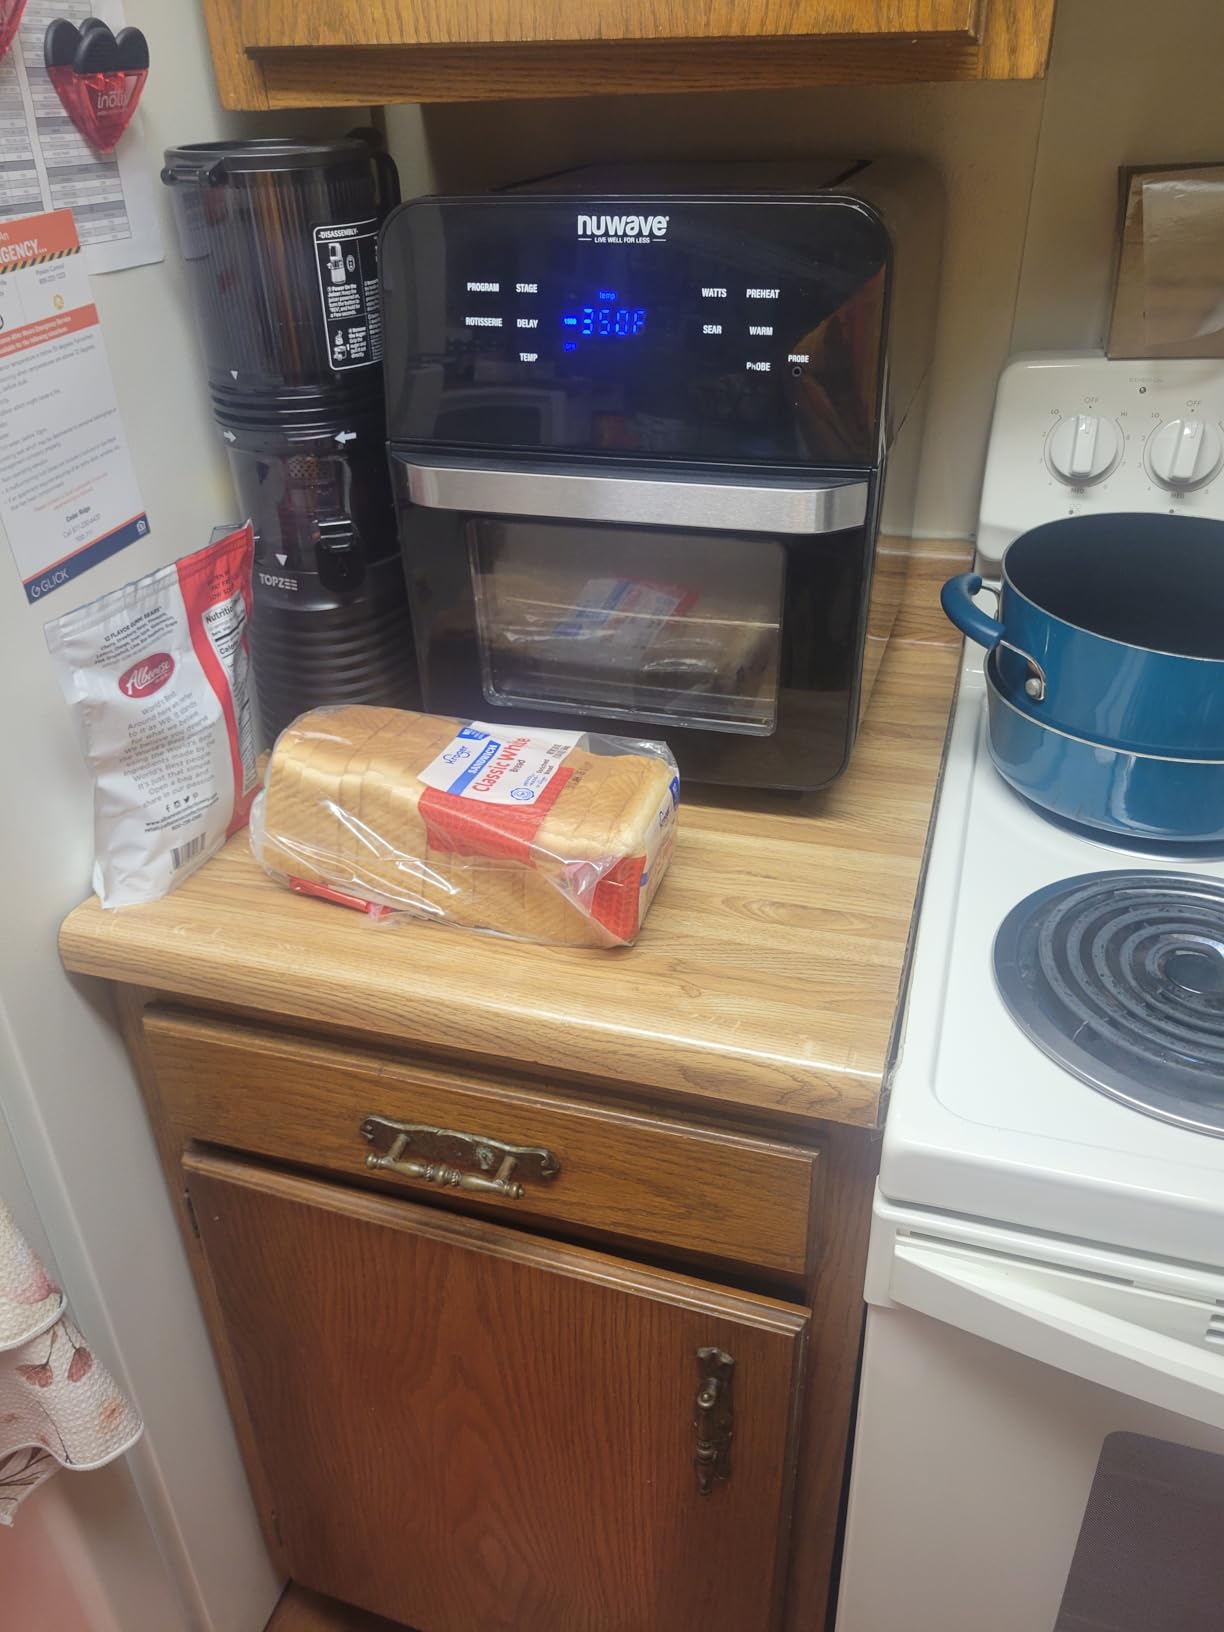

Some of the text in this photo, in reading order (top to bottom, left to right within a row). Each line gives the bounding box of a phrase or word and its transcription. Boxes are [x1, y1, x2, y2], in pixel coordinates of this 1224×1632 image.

[467, 282, 500, 292] PROGRAM
[515, 283, 538, 293] STAGE
[701, 288, 727, 298] WATTS
[746, 289, 780, 299] PREHEAT
[465, 317, 503, 327] ROTISSERIE
[516, 318, 538, 328] DELAY
[702, 325, 722, 334] SEAR
[749, 326, 774, 336] WARM
[519, 352, 538, 362] TEMP
[788, 354, 809, 363] PROBE
[40, 568, 69, 592] GLICK
[443, 745, 471, 764] Kroger
[471, 760, 508, 792] Classic
[500, 736, 531, 765] White
[509, 759, 526, 773] Bread
